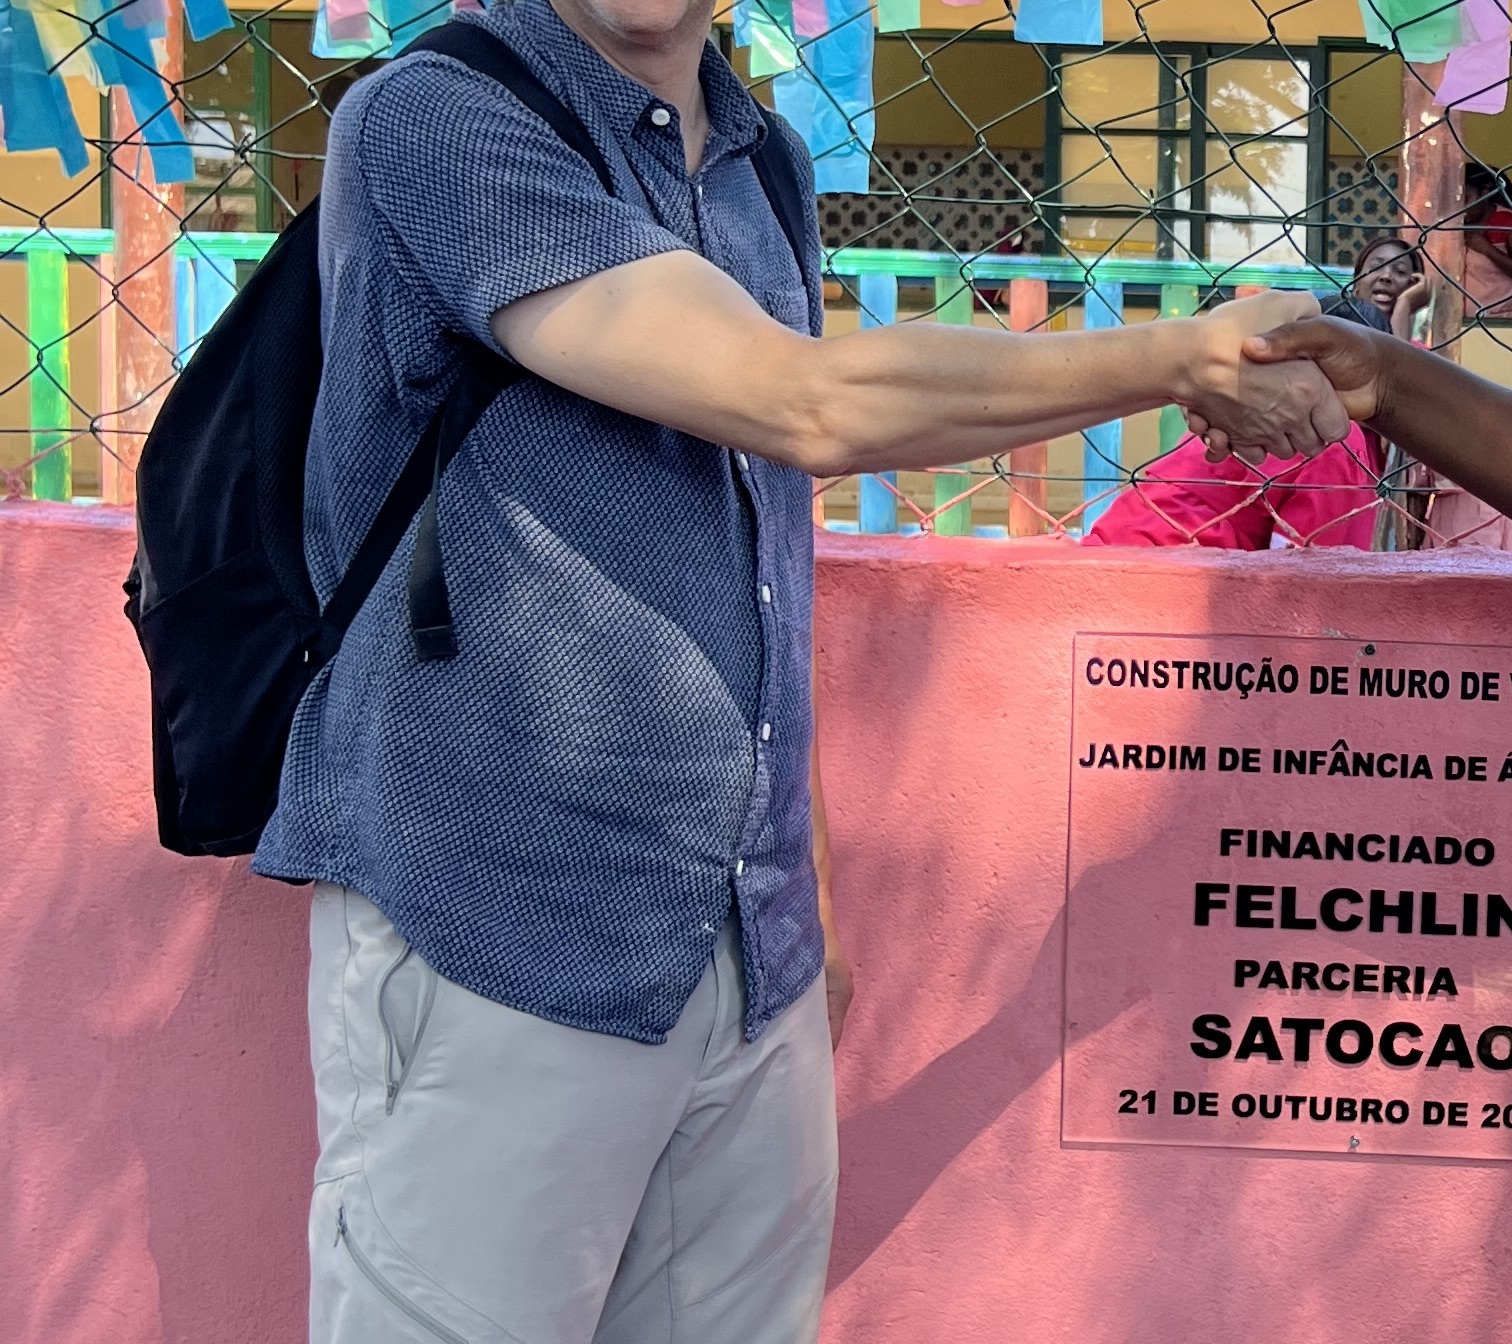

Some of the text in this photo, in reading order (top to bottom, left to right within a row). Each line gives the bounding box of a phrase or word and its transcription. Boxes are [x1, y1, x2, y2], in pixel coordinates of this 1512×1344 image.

[1085, 656, 1300, 700] CONSTRUÇÃO
[1308, 664, 1350, 697] DE
[1358, 666, 1451, 701] MURO
[1459, 670, 1501, 703] DE
[1078, 742, 1207, 772] JARDIM
[1217, 745, 1262, 774] DE
[1272, 738, 1435, 781] INFÂNCIA
[1443, 754, 1489, 783] DE
[1218, 827, 1496, 868] FINANCIADO
[1233, 958, 1459, 997] PARCERIA
[1117, 1088, 1157, 1116] 21
[1172, 1089, 1220, 1118] DE
[1230, 1092, 1411, 1126] OUTUBRO
[1421, 1100, 1470, 1128] DE
